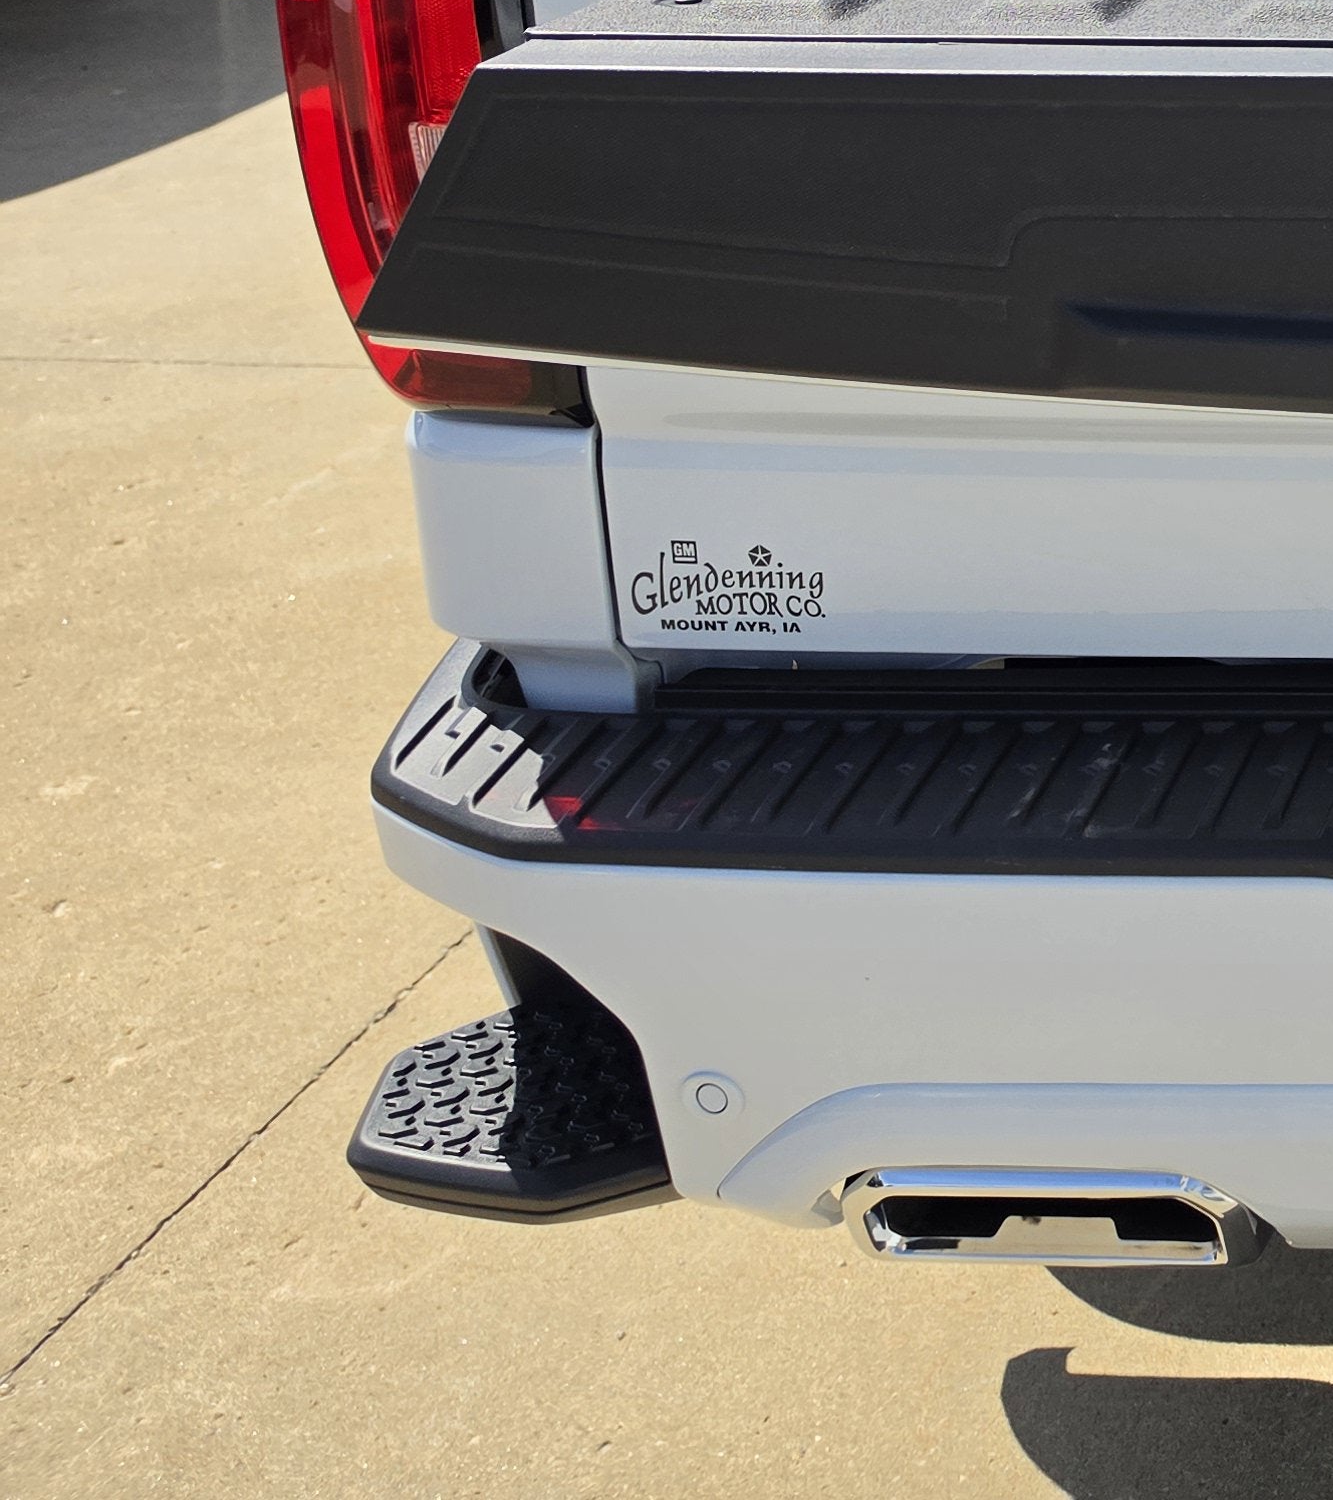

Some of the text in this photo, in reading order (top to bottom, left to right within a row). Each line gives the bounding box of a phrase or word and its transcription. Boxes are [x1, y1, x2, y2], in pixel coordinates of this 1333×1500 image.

[673, 543, 696, 557] GM
[632, 551, 824, 615] Glendenning
[695, 592, 826, 618] MOTOR CO.
[661, 619, 801, 635] MOUNT AYR, IA
